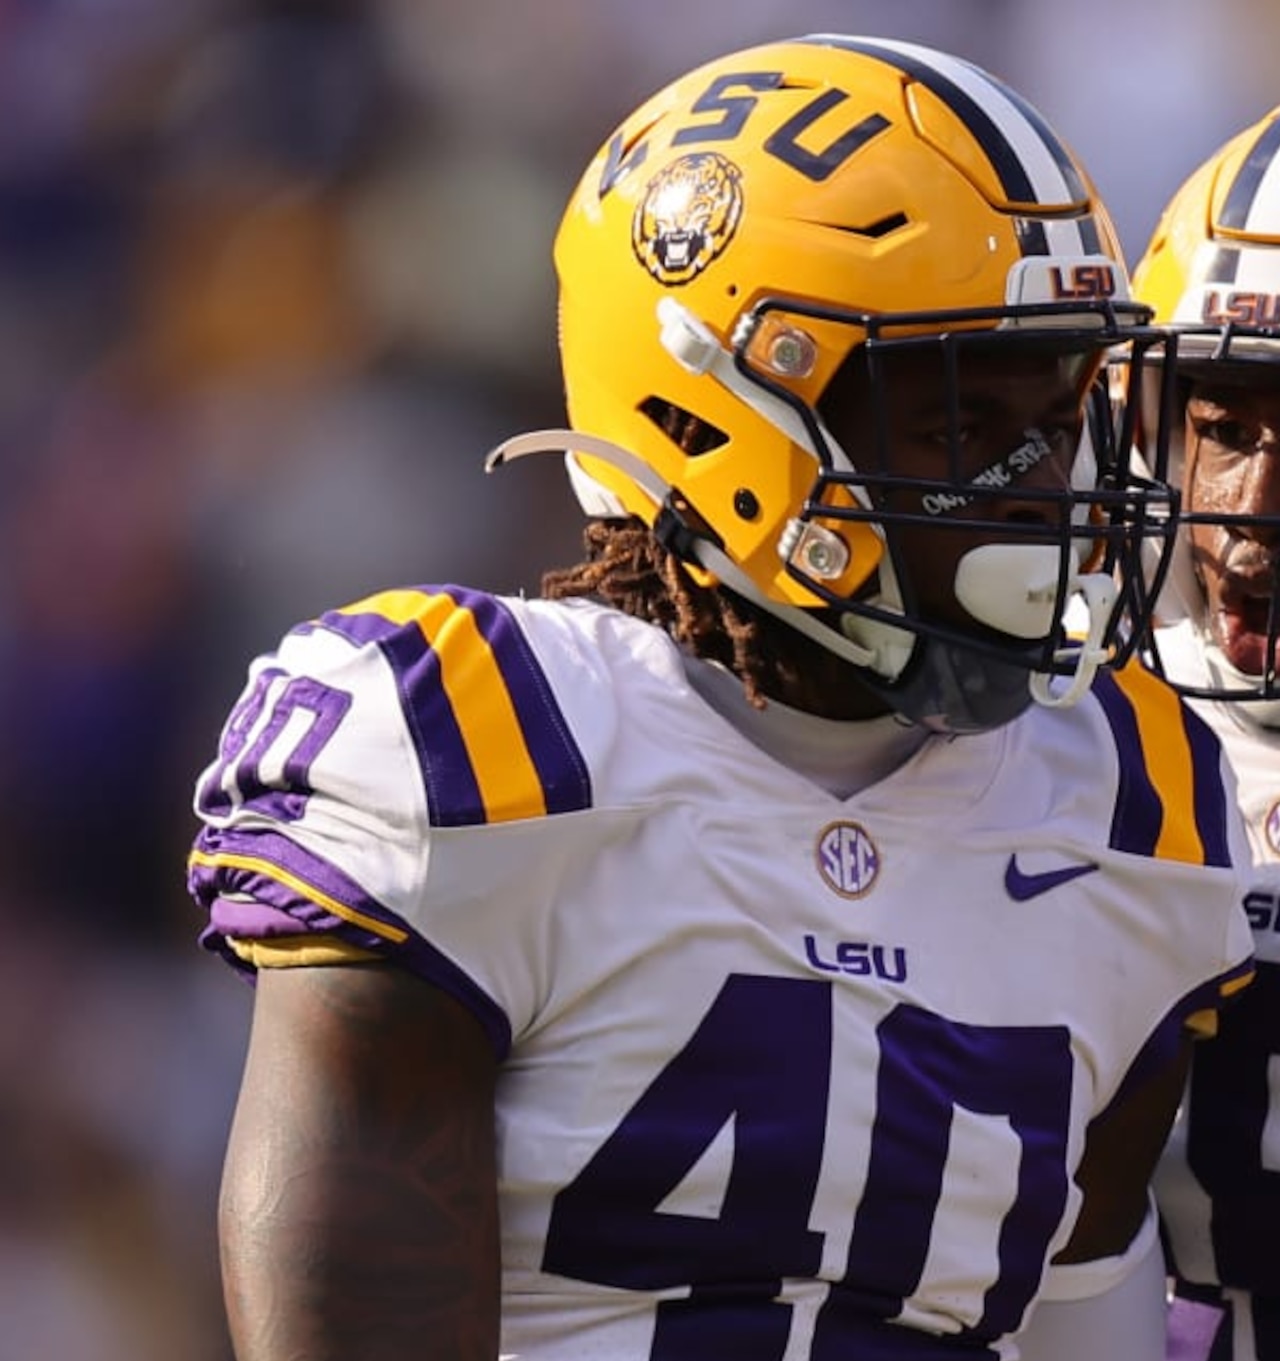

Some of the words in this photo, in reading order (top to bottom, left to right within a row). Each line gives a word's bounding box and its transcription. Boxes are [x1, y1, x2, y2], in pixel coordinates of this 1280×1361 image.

[599, 72, 893, 199] LSU
[1050, 266, 1116, 299] LSU
[819, 825, 879, 895] SEC
[804, 934, 907, 983] LSU
